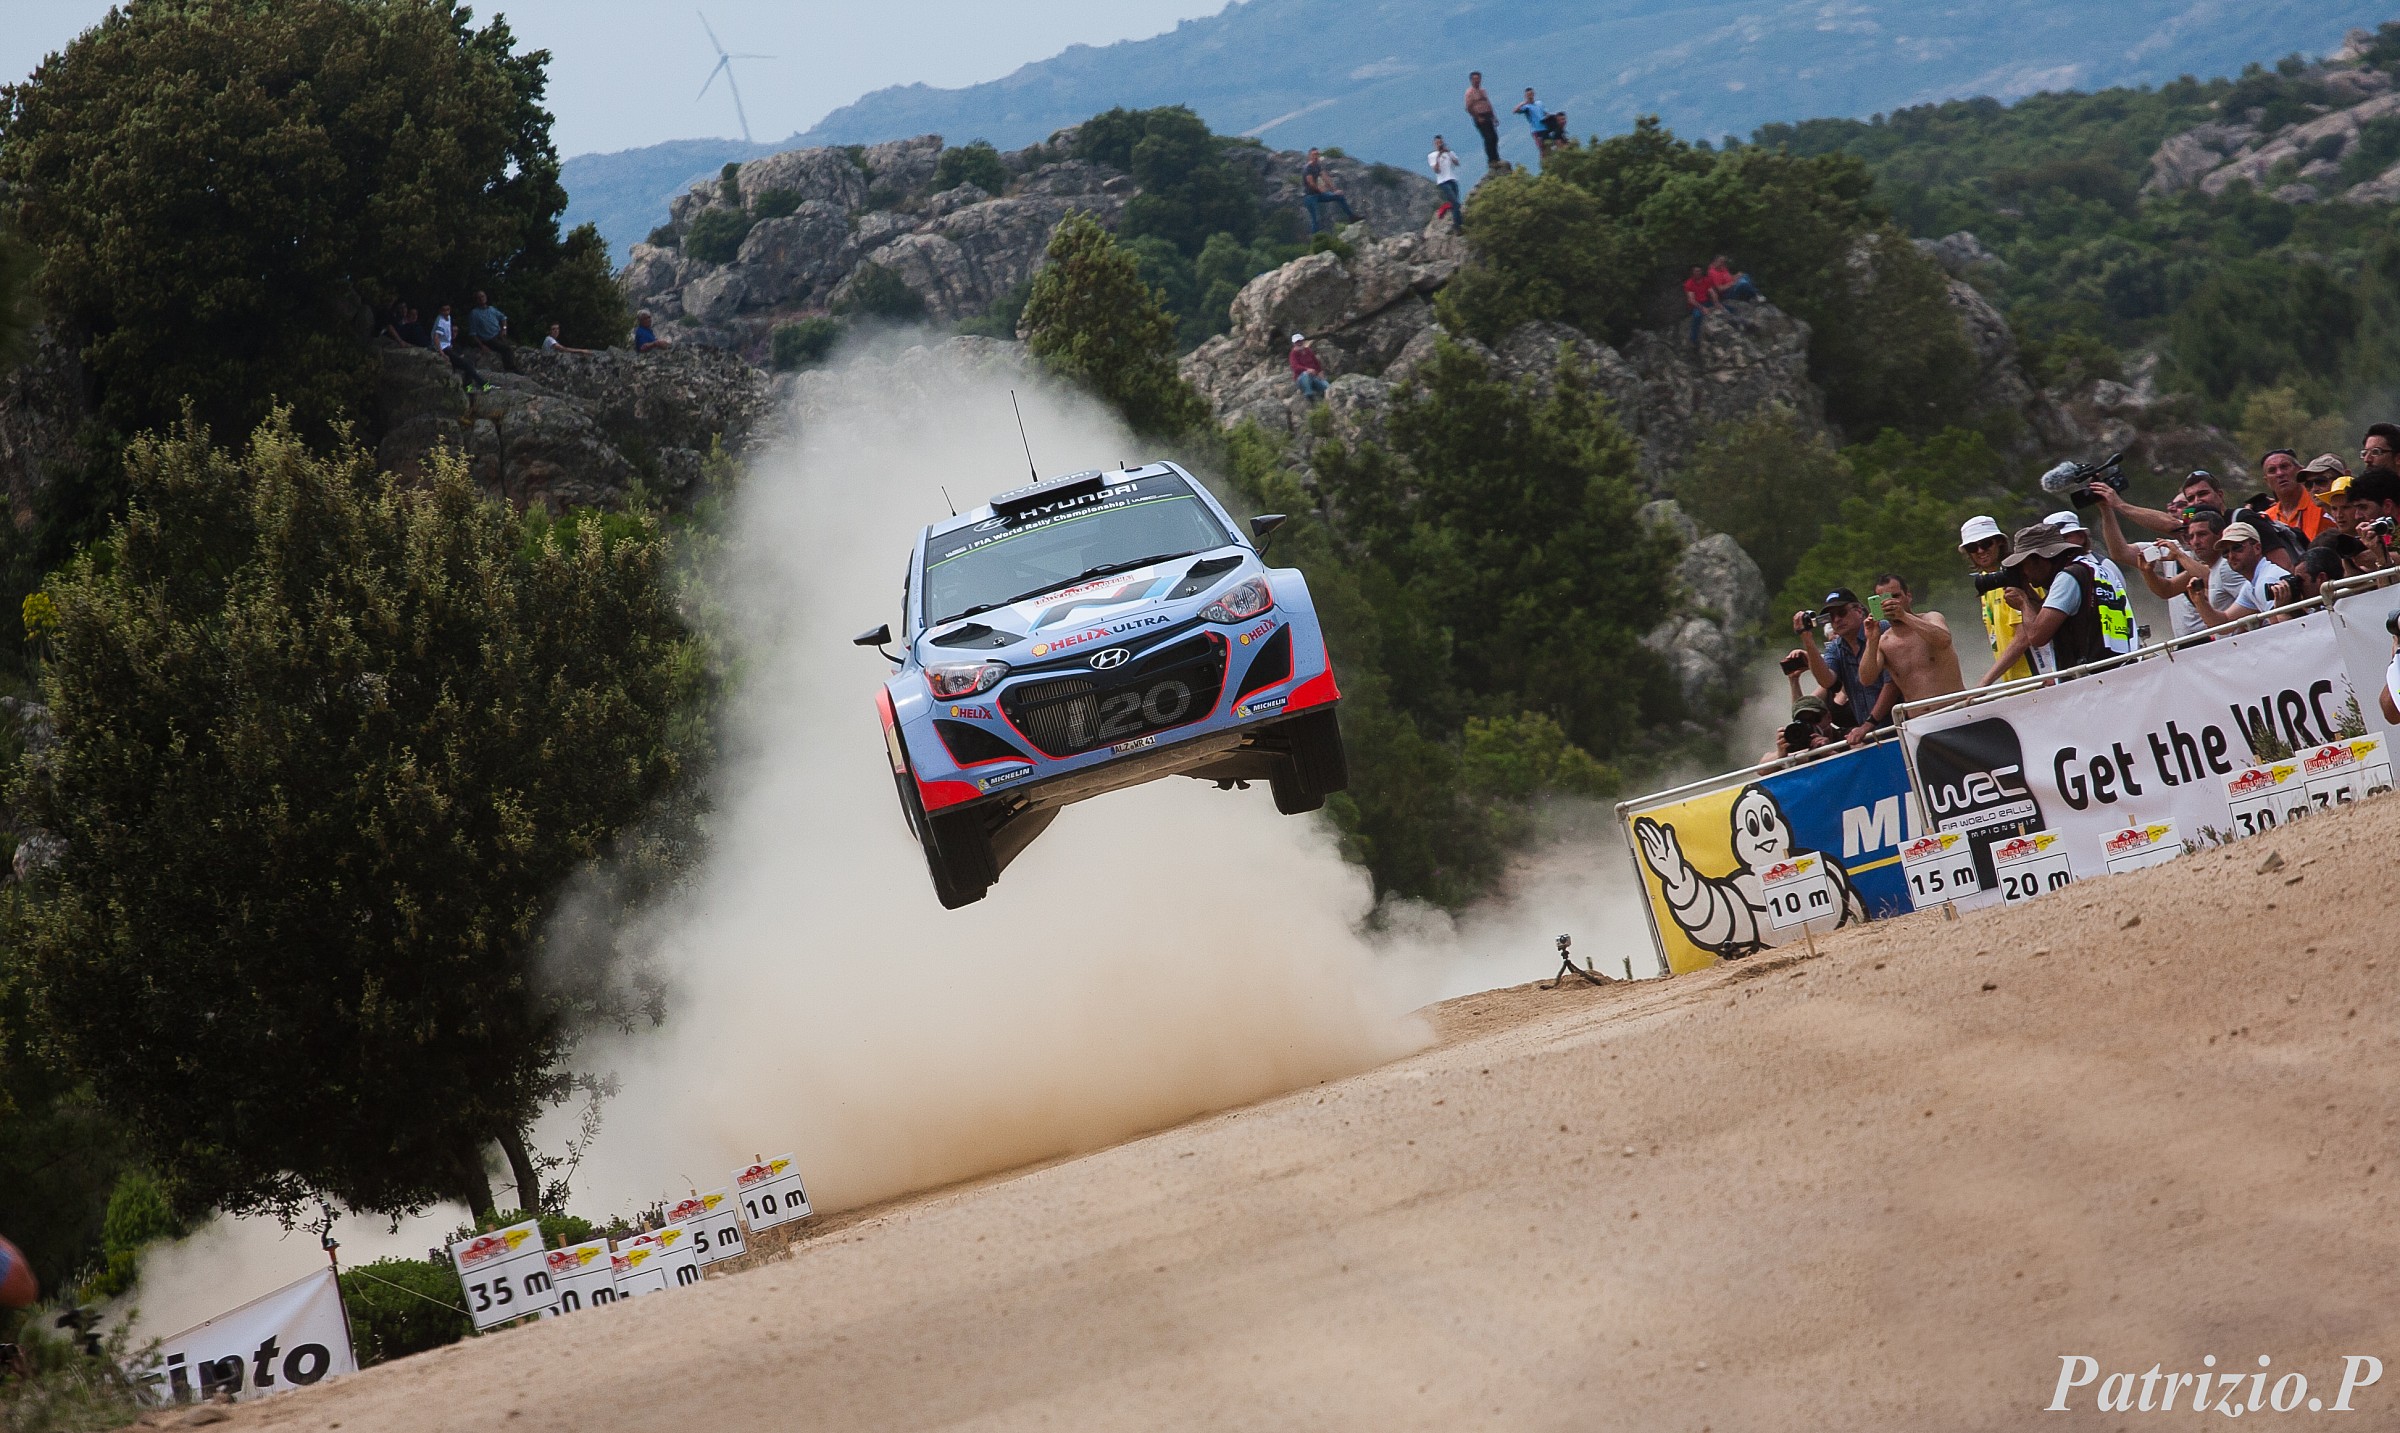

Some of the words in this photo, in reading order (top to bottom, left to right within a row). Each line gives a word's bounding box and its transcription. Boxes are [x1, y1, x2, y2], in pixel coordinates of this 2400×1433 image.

[1020, 483, 1138, 519] HYUNDAI
[974, 537, 992, 547] FIA
[993, 526, 1023, 541] World
[1025, 517, 1051, 531] Rally
[1053, 500, 1126, 522] Championship
[1050, 628, 1110, 651] HELIX
[1113, 614, 1170, 633] ULTRA
[1249, 618, 1277, 641] HELIX
[959, 704, 993, 720] HELIX
[1253, 697, 1286, 713] MICHELIN
[2054, 742, 2142, 811] Get
[2147, 720, 2233, 786] the
[2230, 679, 2341, 757] WRC
[990, 768, 1030, 785] MICHELIN
[1928, 764, 2028, 814] WRC
[1941, 821, 1958, 832] FIA
[1960, 813, 1997, 828] WORLD
[1999, 803, 2033, 818] RALLY
[2236, 808, 2276, 836] 30
[1911, 870, 1945, 896] 15
[1953, 866, 1975, 887] m
[2002, 872, 2039, 901] 20
[2047, 870, 2070, 892] m
[1769, 892, 1801, 918] 10
[1809, 889, 1830, 908] m
[745, 1194, 777, 1220] 10
[784, 1189, 806, 1209] m
[717, 1226, 740, 1247] m
[676, 1263, 699, 1287] m
[469, 1276, 514, 1312] 35
[523, 1270, 552, 1296] m
[140, 1335, 331, 1402] into
